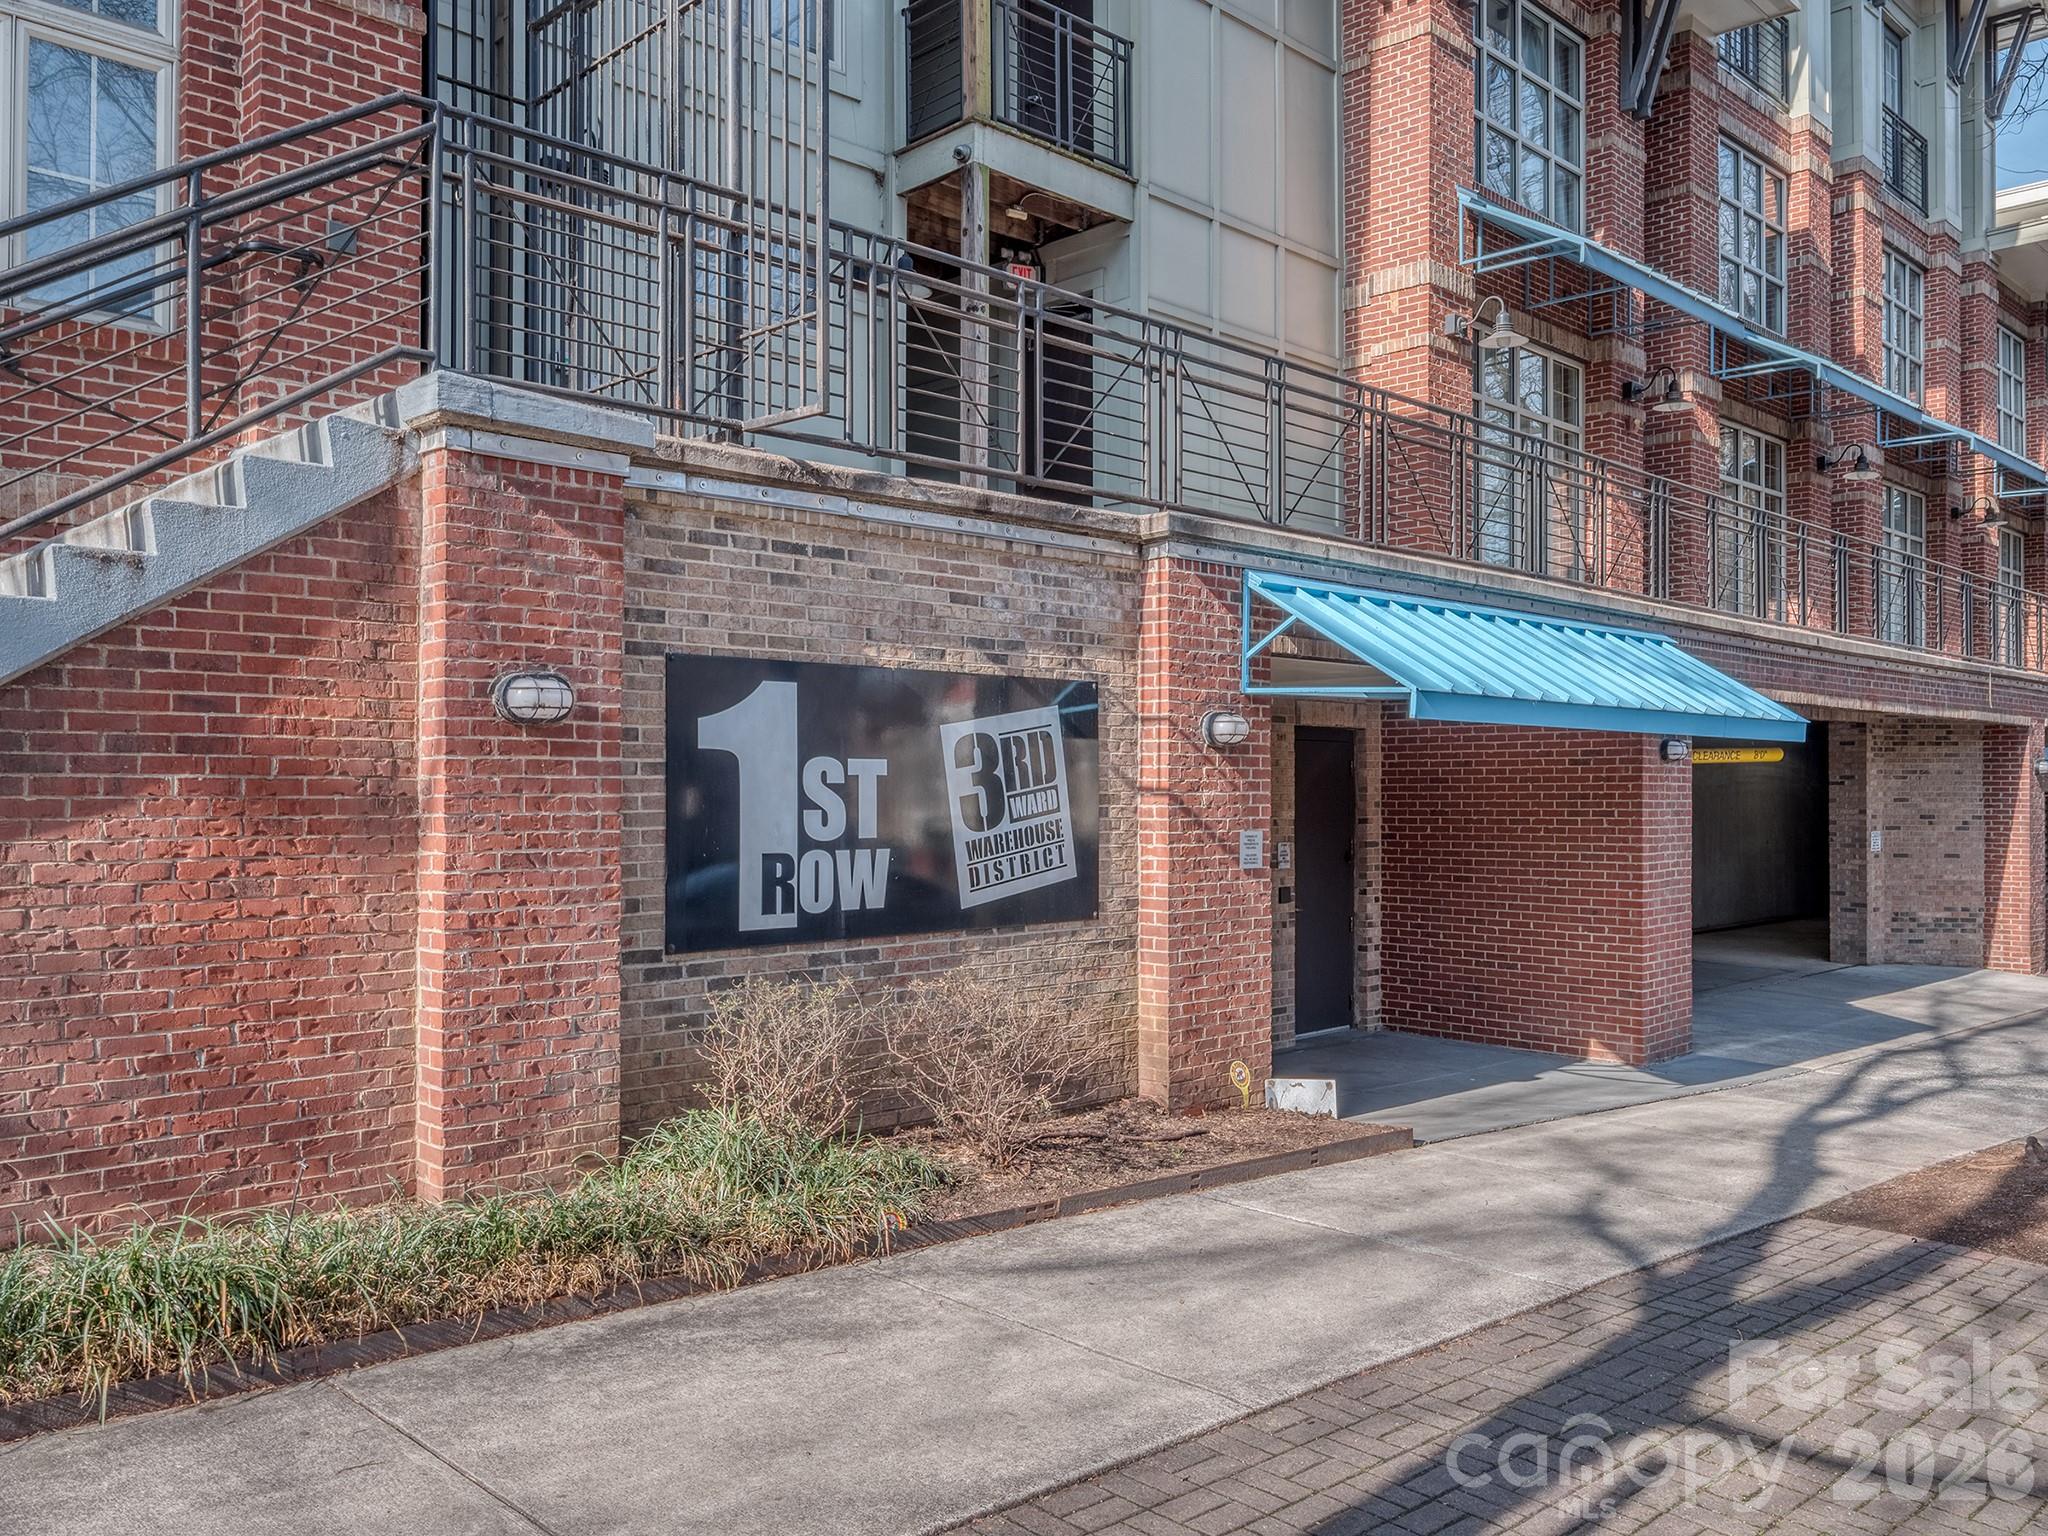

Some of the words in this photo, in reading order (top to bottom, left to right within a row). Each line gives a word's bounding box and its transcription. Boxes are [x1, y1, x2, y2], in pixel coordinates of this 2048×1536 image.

[1692, 750, 1741, 761] CLEARANCE
[953, 730, 1057, 833] 3RD
[1009, 788, 1059, 819] WARD
[965, 818, 1064, 862] WAREHOUSE
[761, 848, 891, 915] ROW
[968, 844, 1065, 889] DISTRICT
